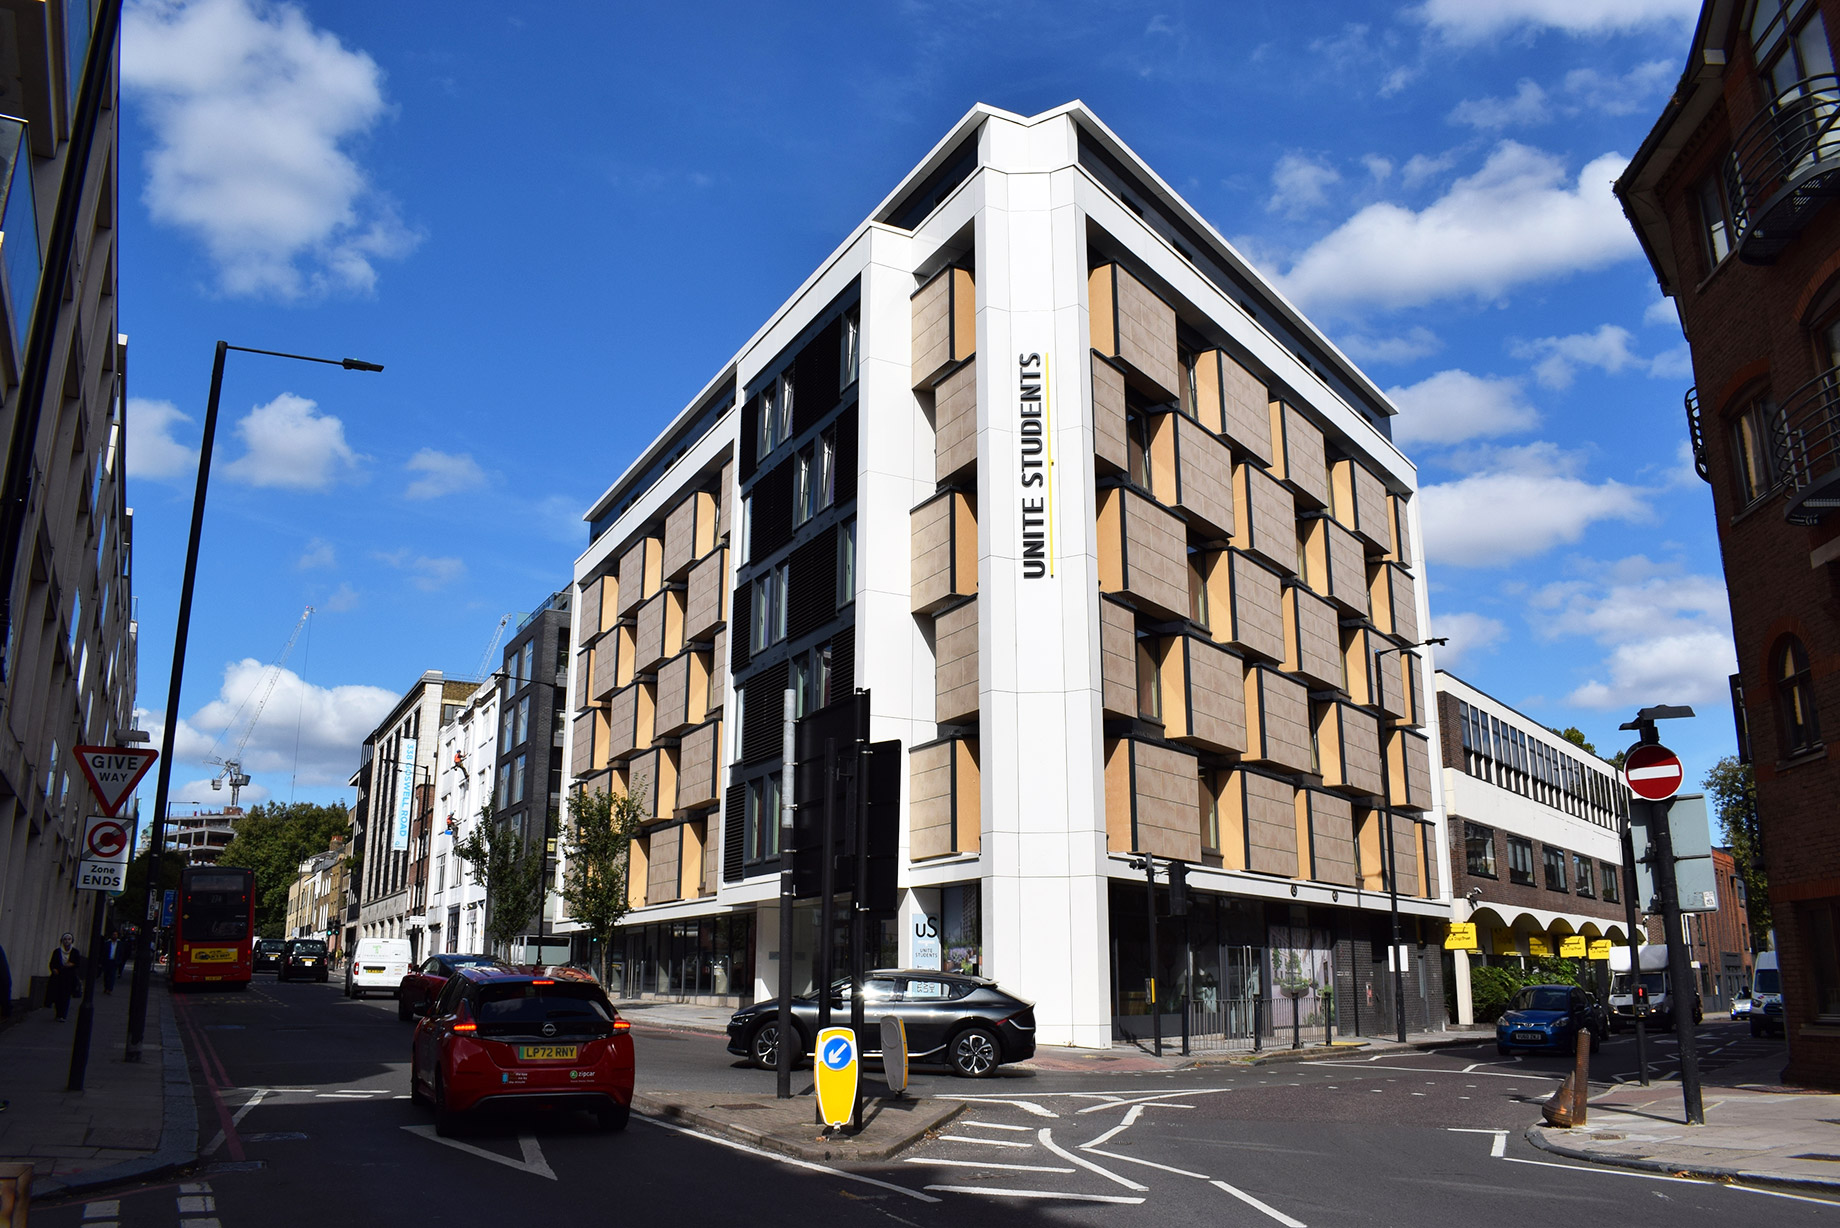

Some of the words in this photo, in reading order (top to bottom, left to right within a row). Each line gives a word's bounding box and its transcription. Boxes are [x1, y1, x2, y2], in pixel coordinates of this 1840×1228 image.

[1019, 352, 1044, 488] STUDENTS
[1022, 497, 1045, 579] UNITE
[406, 744, 414, 760] 338
[91, 755, 138, 770] GIVE
[99, 772, 129, 783] WAY
[401, 762, 413, 808] GOSWELL
[399, 809, 408, 837] ROAD
[90, 864, 115, 874] Zone
[82, 875, 121, 887] ENDS
[526, 1047, 553, 1058] LP72
[555, 1047, 575, 1057] RNY
